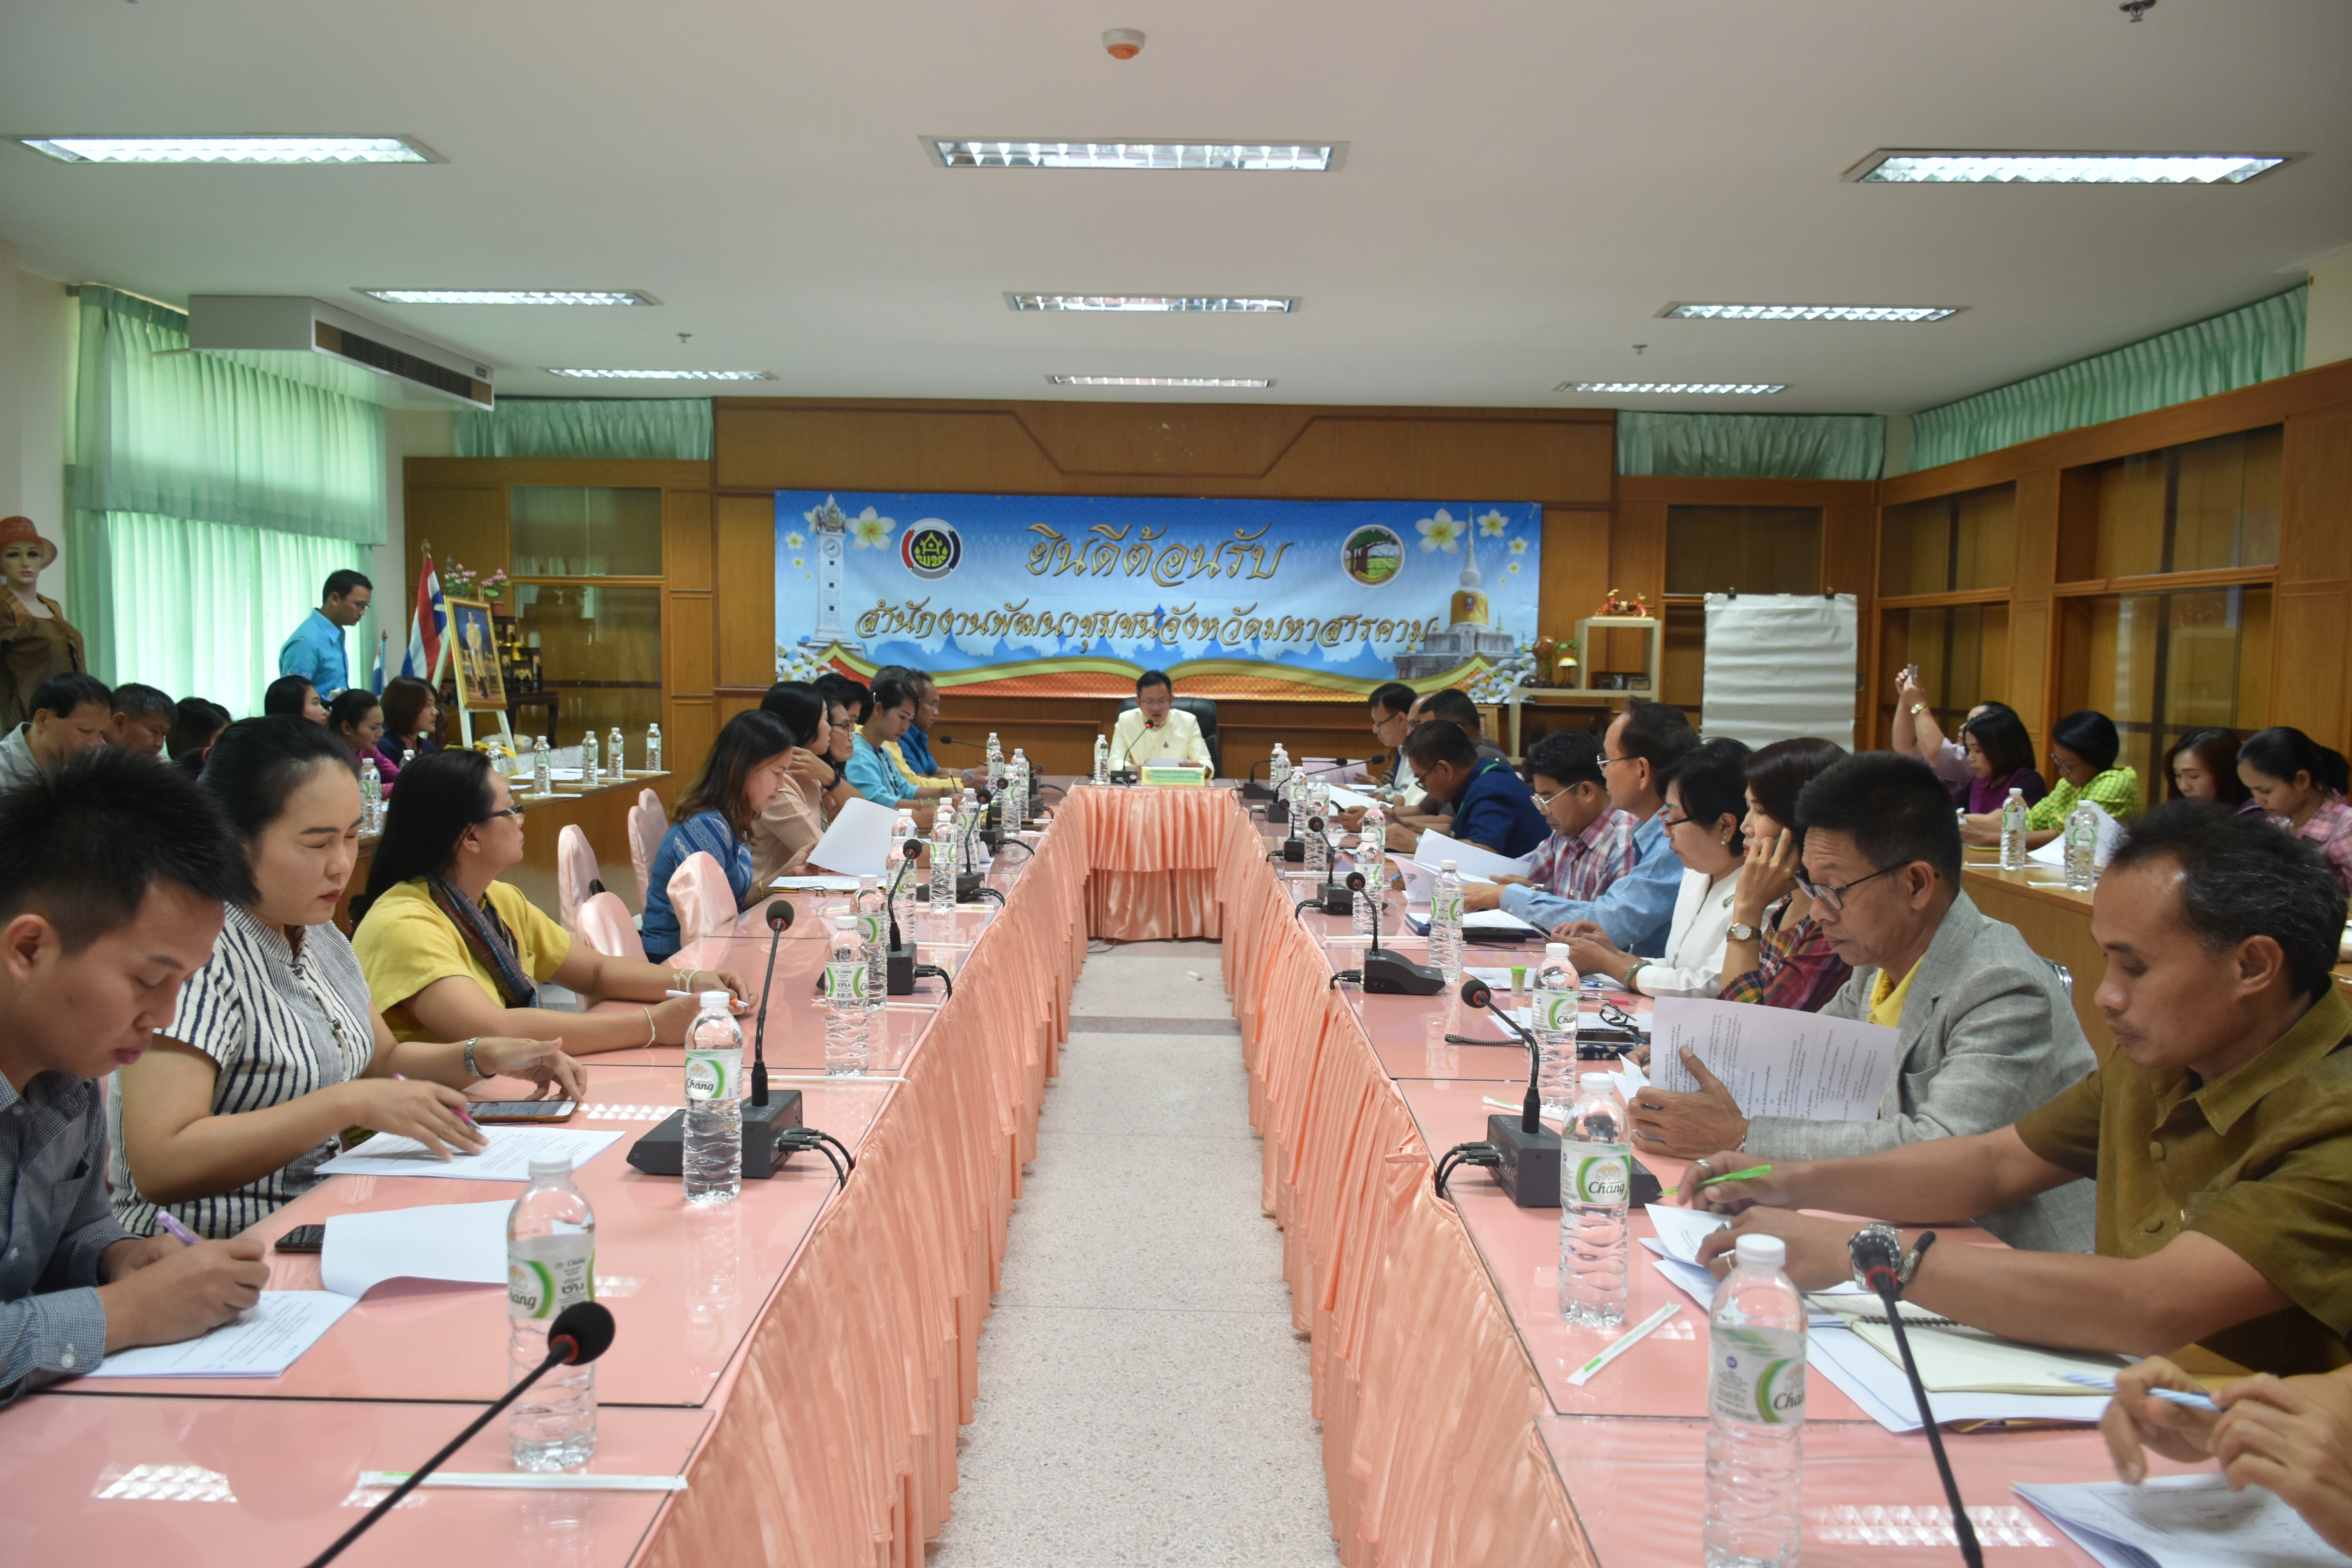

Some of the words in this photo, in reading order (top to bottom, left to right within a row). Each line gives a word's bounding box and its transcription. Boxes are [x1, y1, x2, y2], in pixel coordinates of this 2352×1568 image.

[1026, 521, 1294, 587] ยินดีต้อนรับ
[855, 596, 1439, 654] สำนักงานพัฒนาชุมชนจังหวัดมหาสารคาม
[686, 1078, 714, 1093] Chang
[1588, 1181, 1625, 1194] Chang
[1773, 1392, 1805, 1410] Cha
